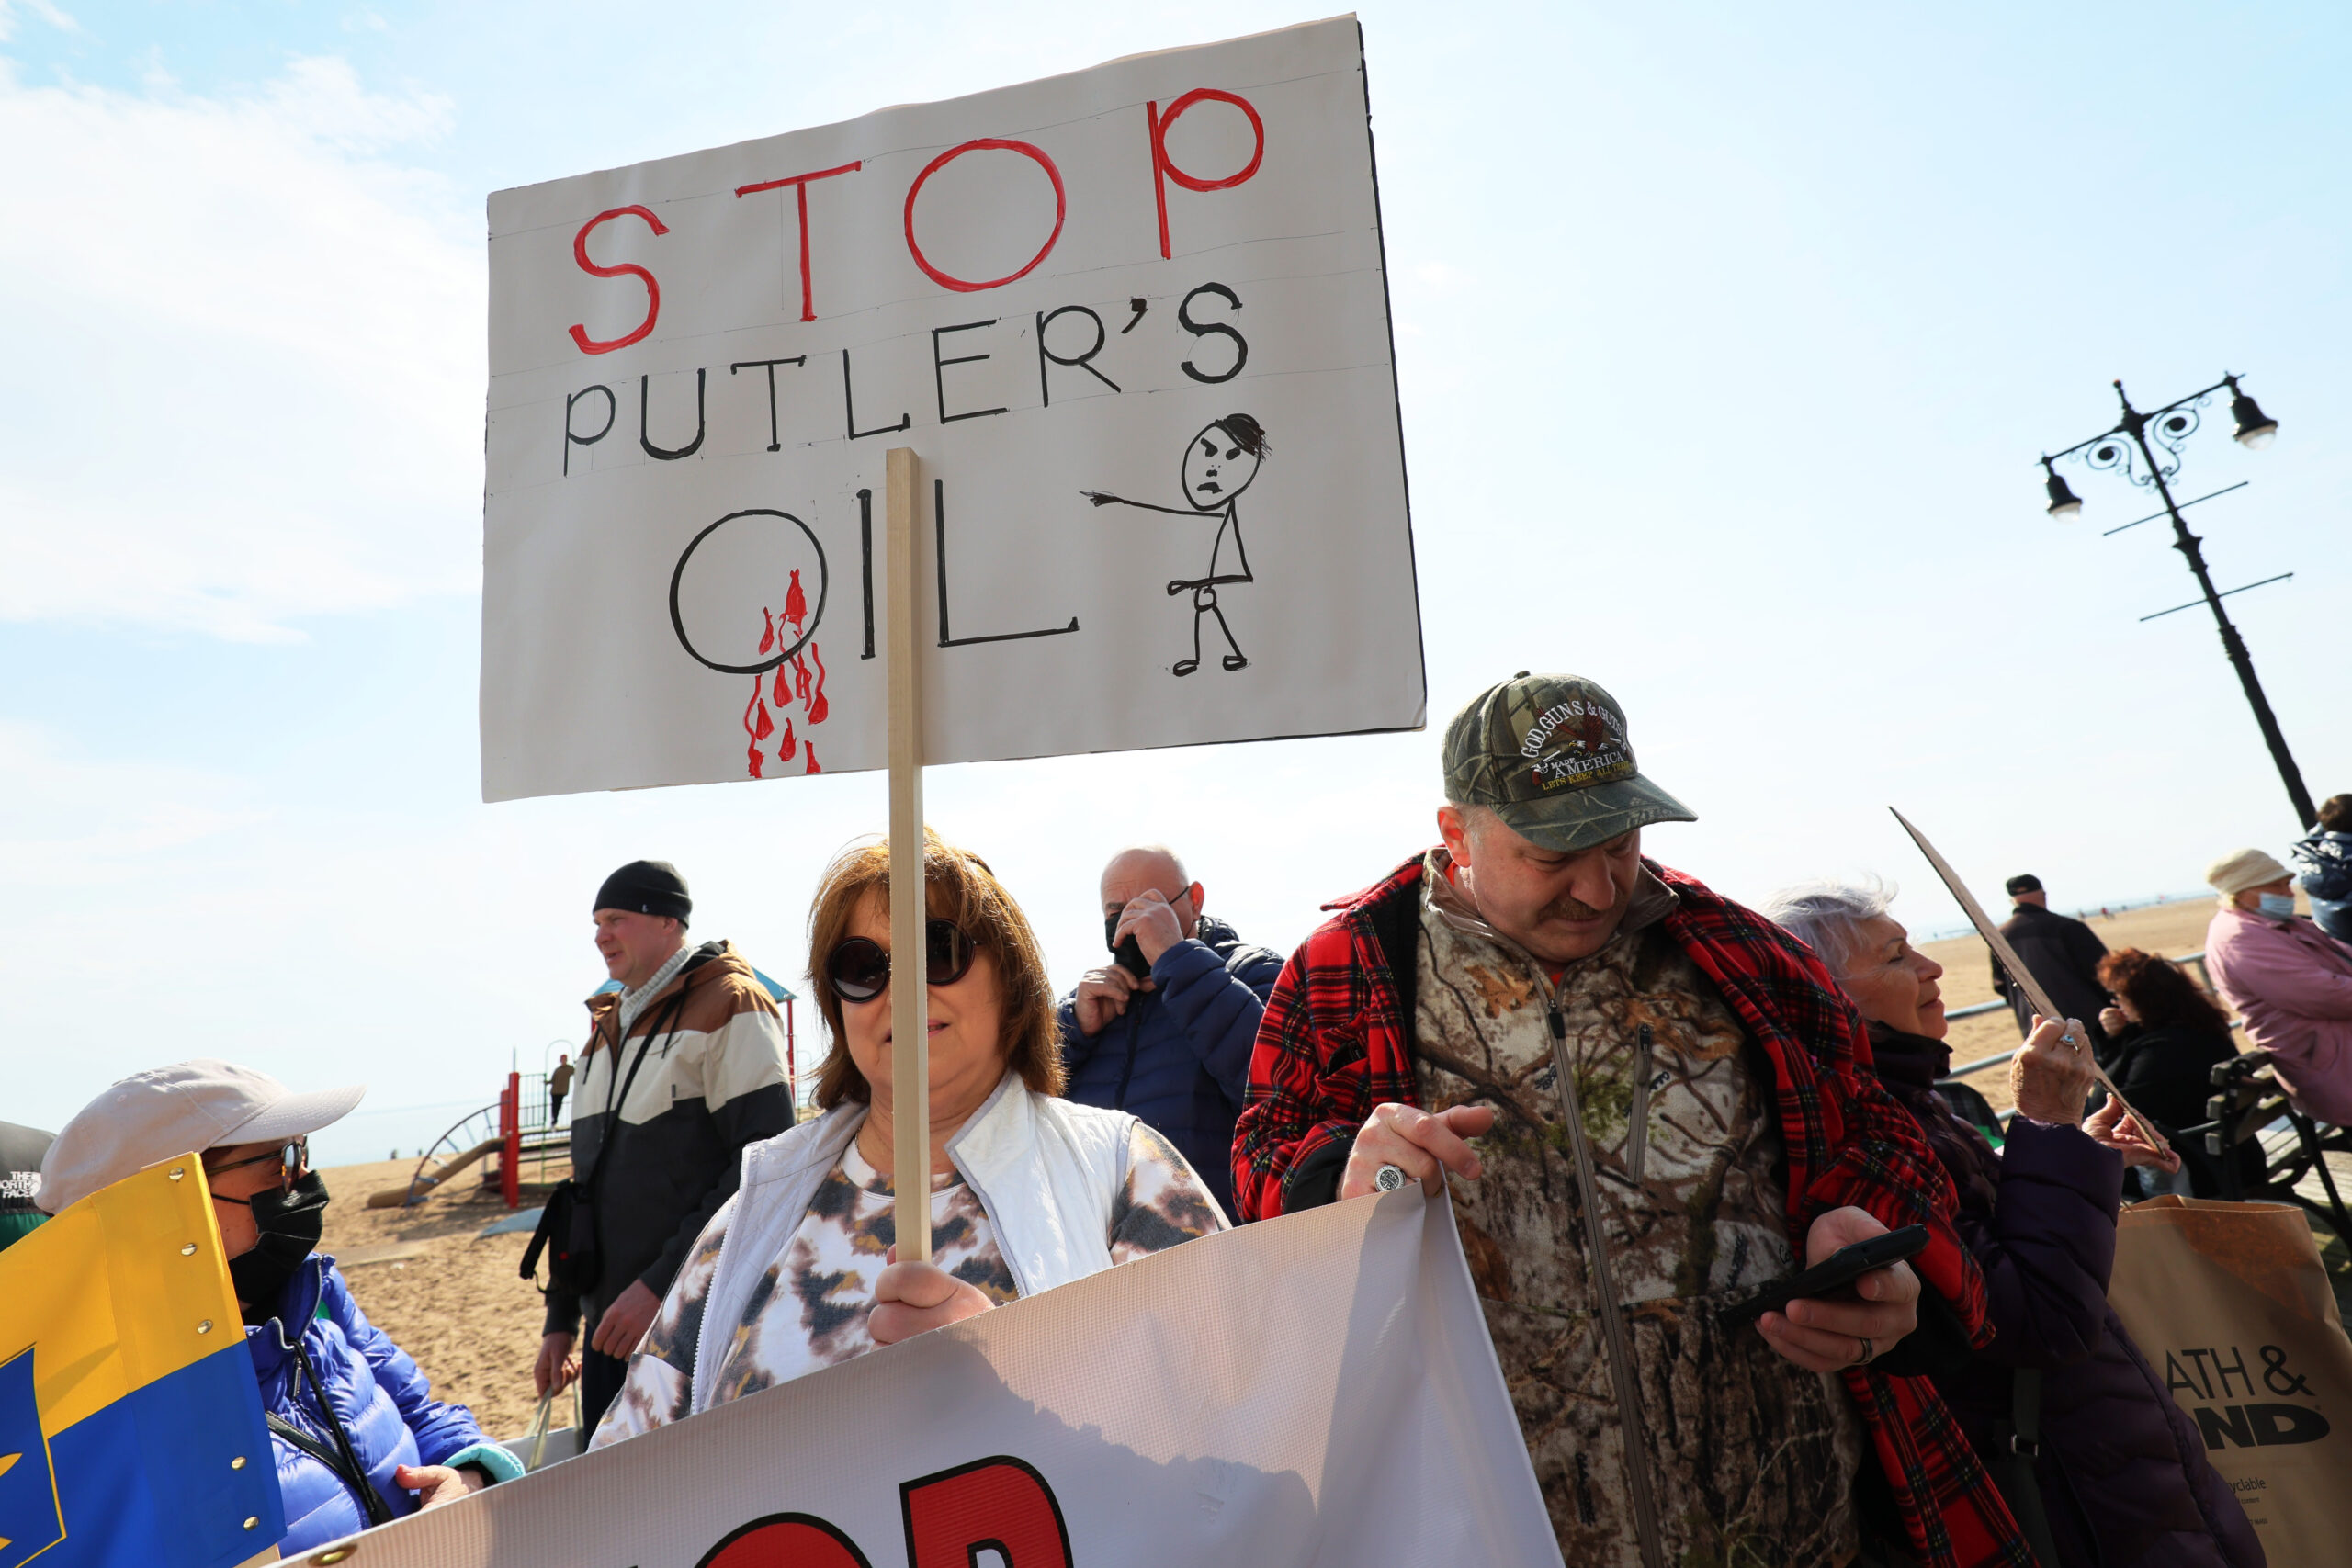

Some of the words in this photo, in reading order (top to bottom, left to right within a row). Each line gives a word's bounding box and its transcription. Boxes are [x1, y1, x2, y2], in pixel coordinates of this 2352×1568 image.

[568, 87, 1265, 355] STOP
[563, 282, 1249, 476] PUTLER'S
[669, 479, 1080, 675] OIL
[1539, 700, 1585, 730] GUNS
[1587, 701, 1598, 716] &
[1550, 757, 1577, 770] MADE
[1554, 750, 1624, 780] AMERICA
[1566, 770, 1594, 784] KEEP
[1596, 764, 1614, 778] ALL
[0, 1179, 32, 1190] ORTH
[10, 1171, 32, 1180] THE
[2, 1189, 31, 1199] FACE
[2258, 1344, 2317, 1397] &
